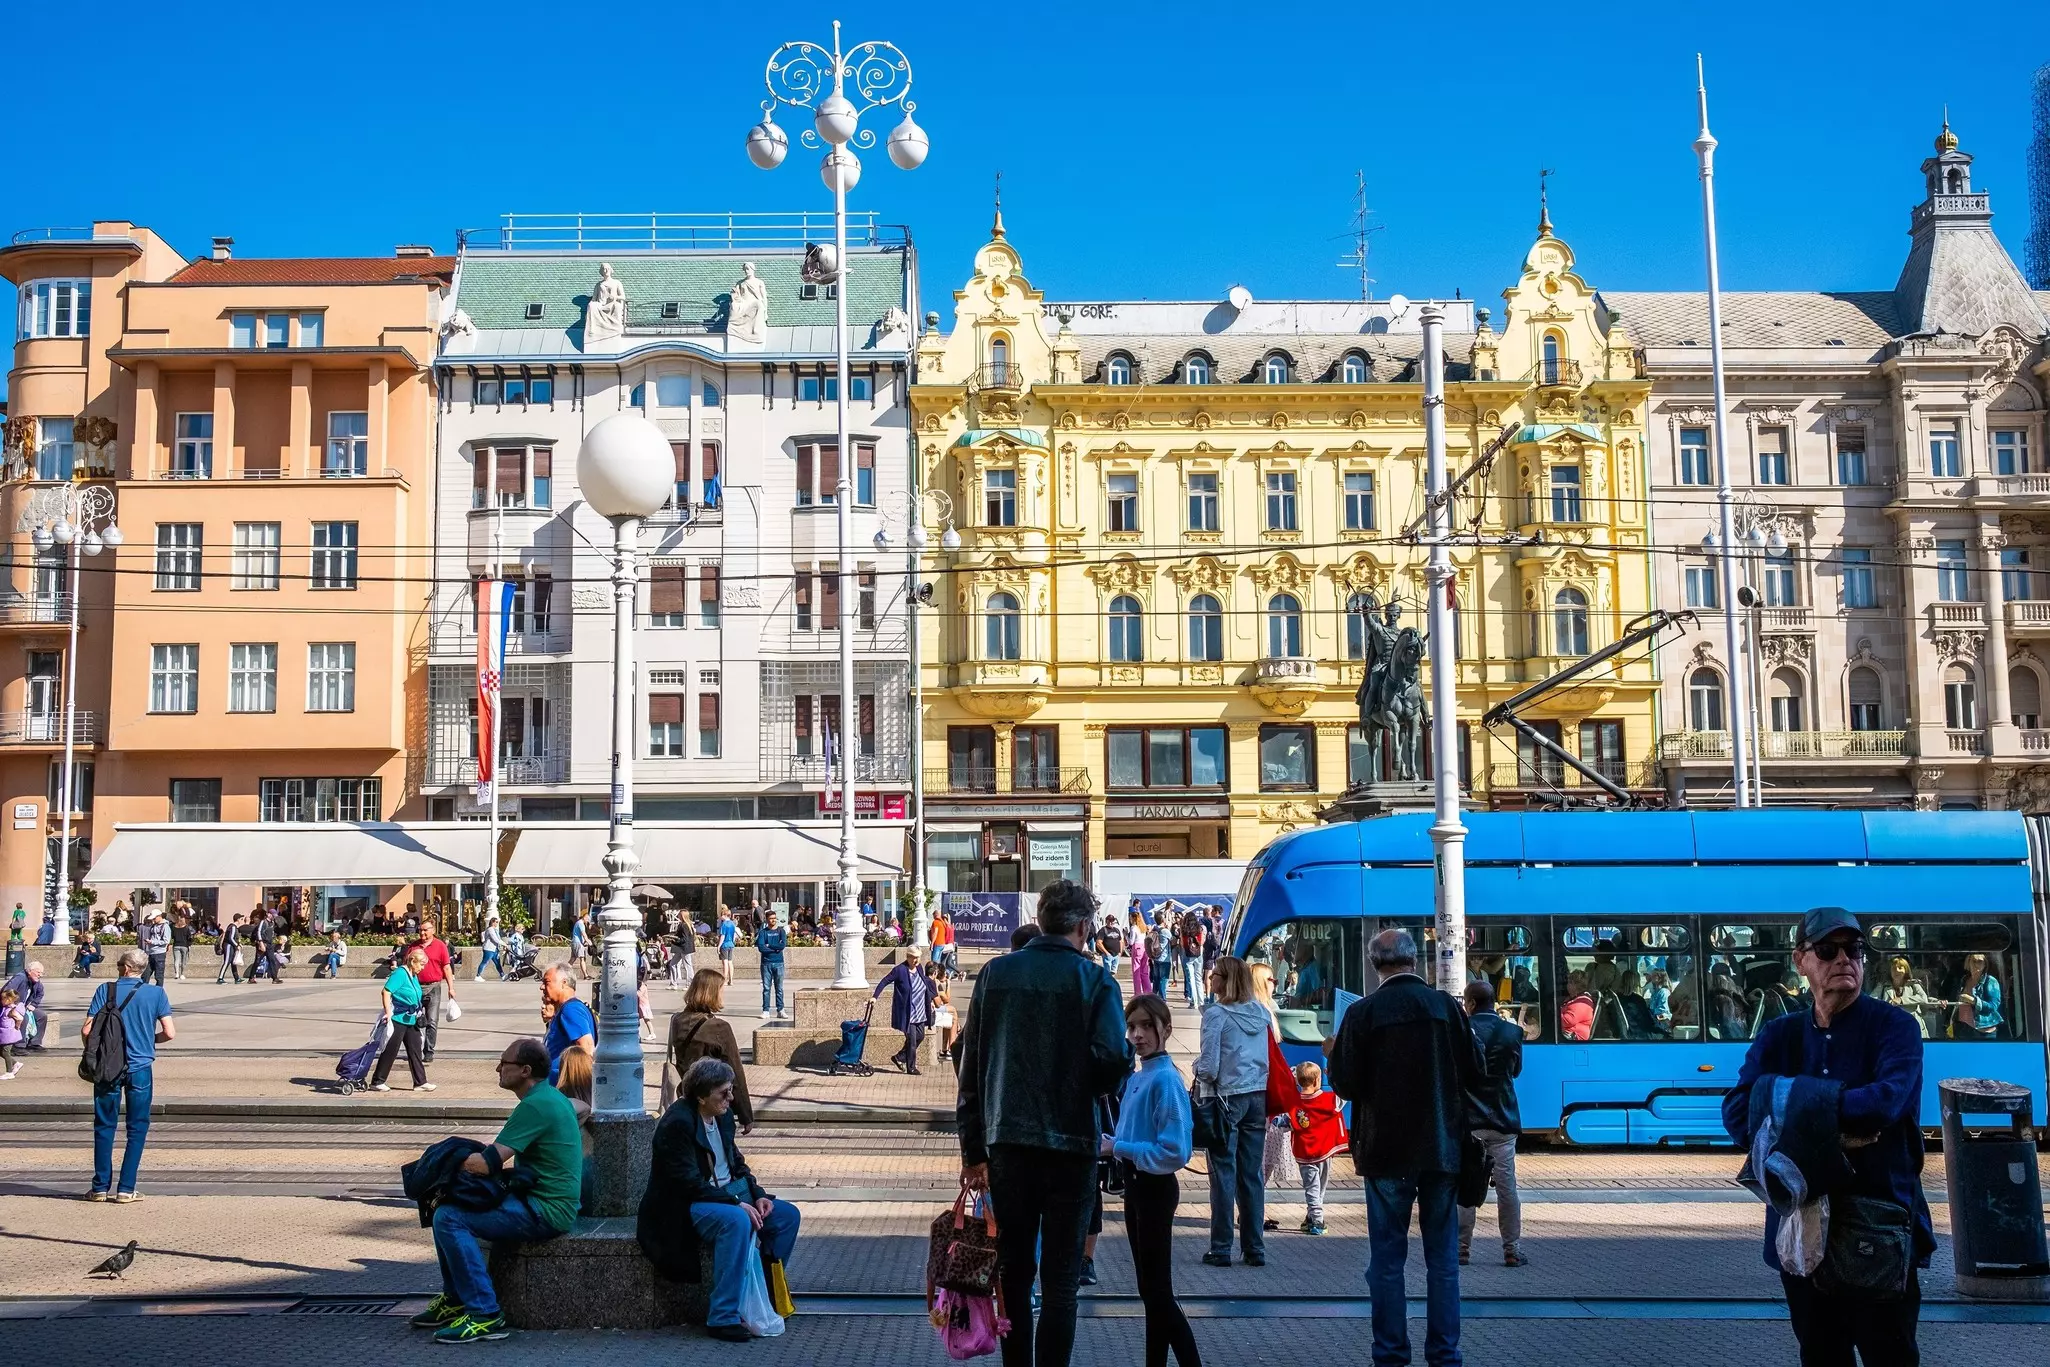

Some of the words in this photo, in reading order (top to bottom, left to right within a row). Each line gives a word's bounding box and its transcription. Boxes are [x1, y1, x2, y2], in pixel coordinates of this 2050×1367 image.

[1031, 806, 1060, 814] Mala
[1134, 806, 1199, 817] HARMICA
[971, 922, 993, 933] PROJEKT
[1303, 923, 1331, 940] 0602
